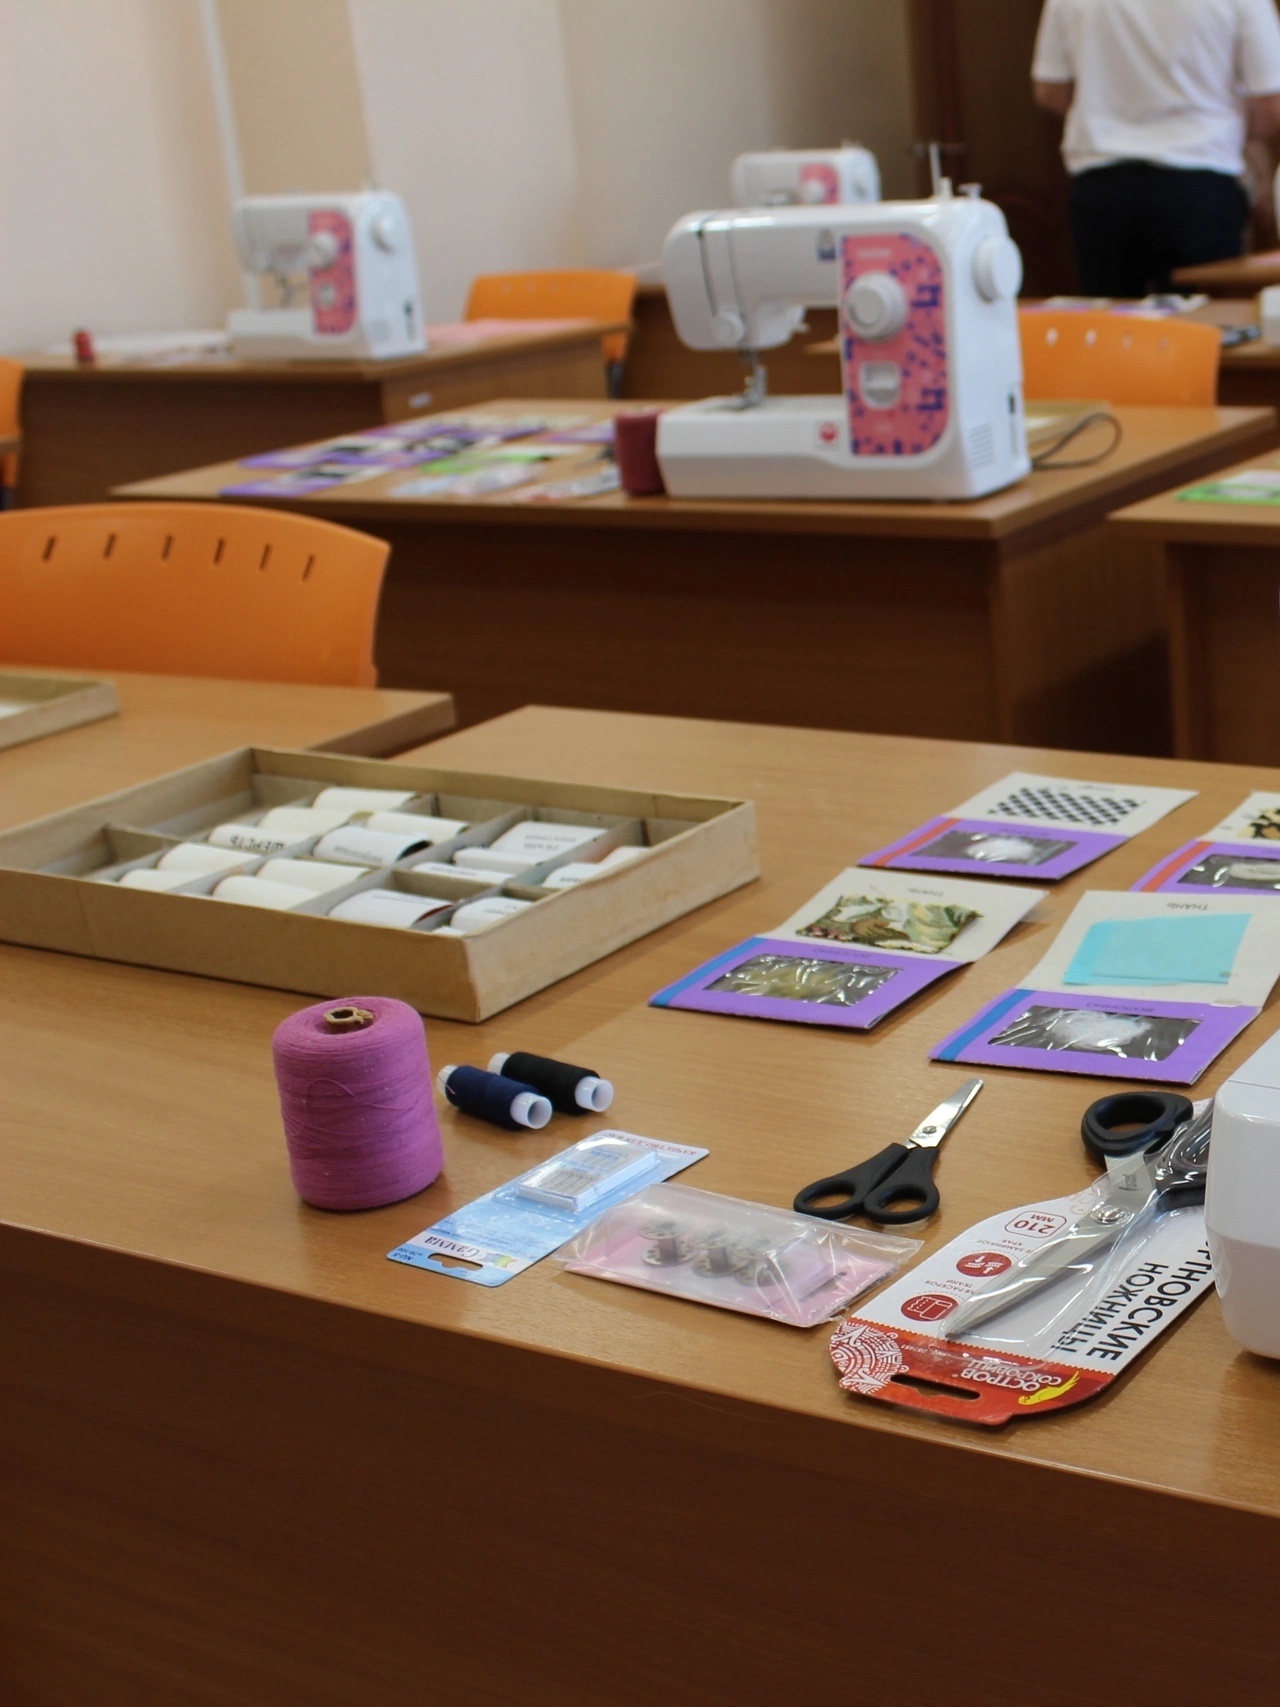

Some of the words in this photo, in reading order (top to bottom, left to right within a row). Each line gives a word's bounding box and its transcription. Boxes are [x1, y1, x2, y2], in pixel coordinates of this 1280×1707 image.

[1013, 1219, 1055, 1234] 210
[1051, 1262, 1170, 1353] НОЖНИЦЫ
[960, 1368, 1040, 1392] ОСТРОВ
